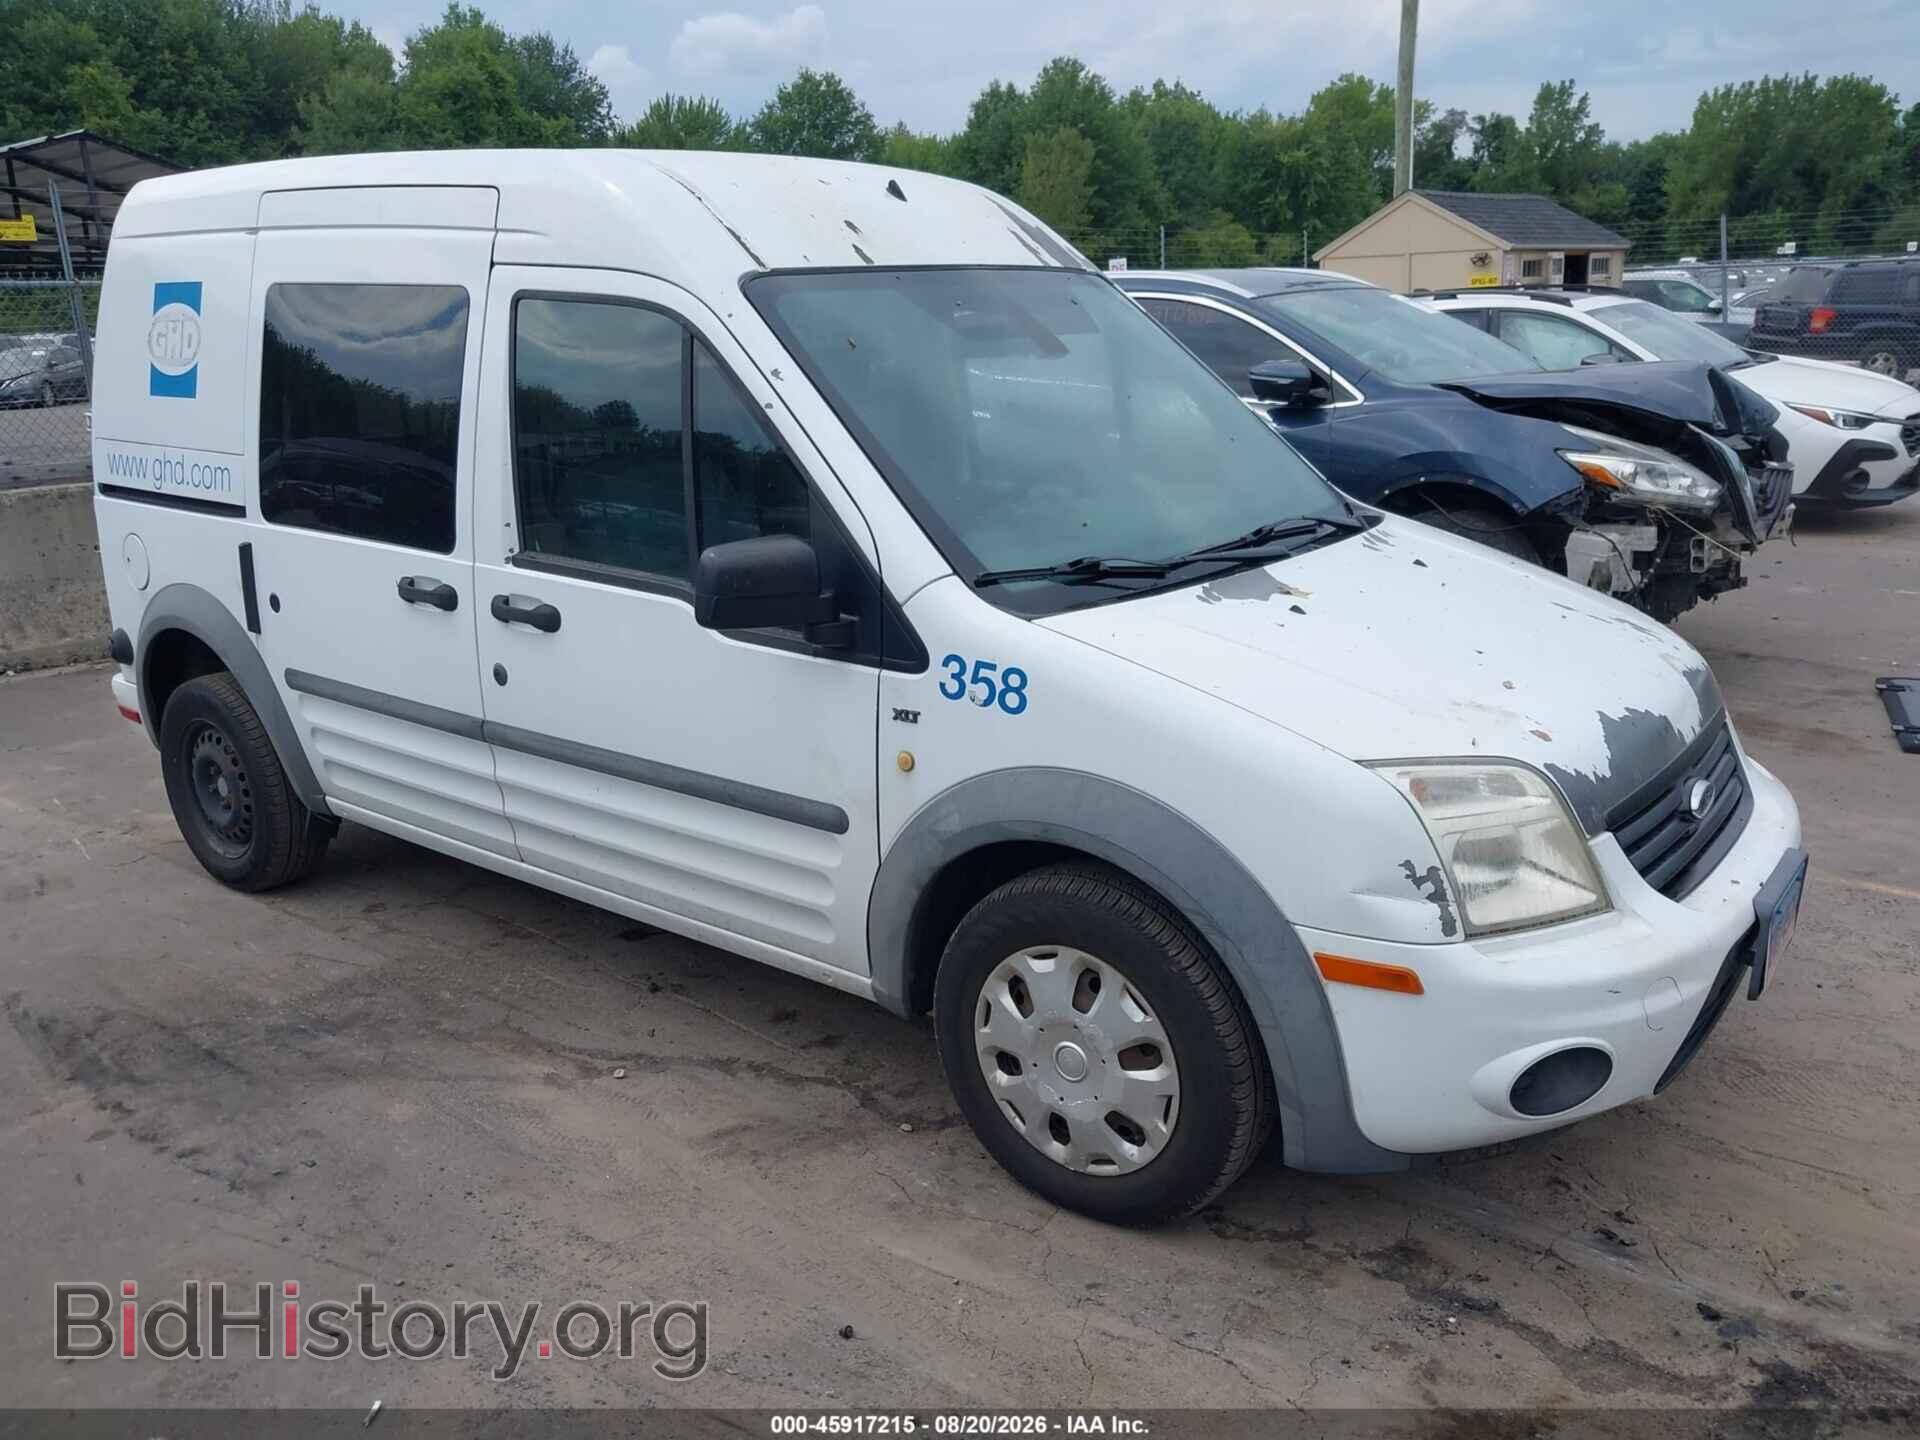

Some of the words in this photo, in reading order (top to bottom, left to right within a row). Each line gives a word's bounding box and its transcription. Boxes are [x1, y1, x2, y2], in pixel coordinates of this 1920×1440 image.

[148, 319, 201, 361] GHD
[939, 654, 1028, 716] 358
[892, 707, 921, 724] XLT
